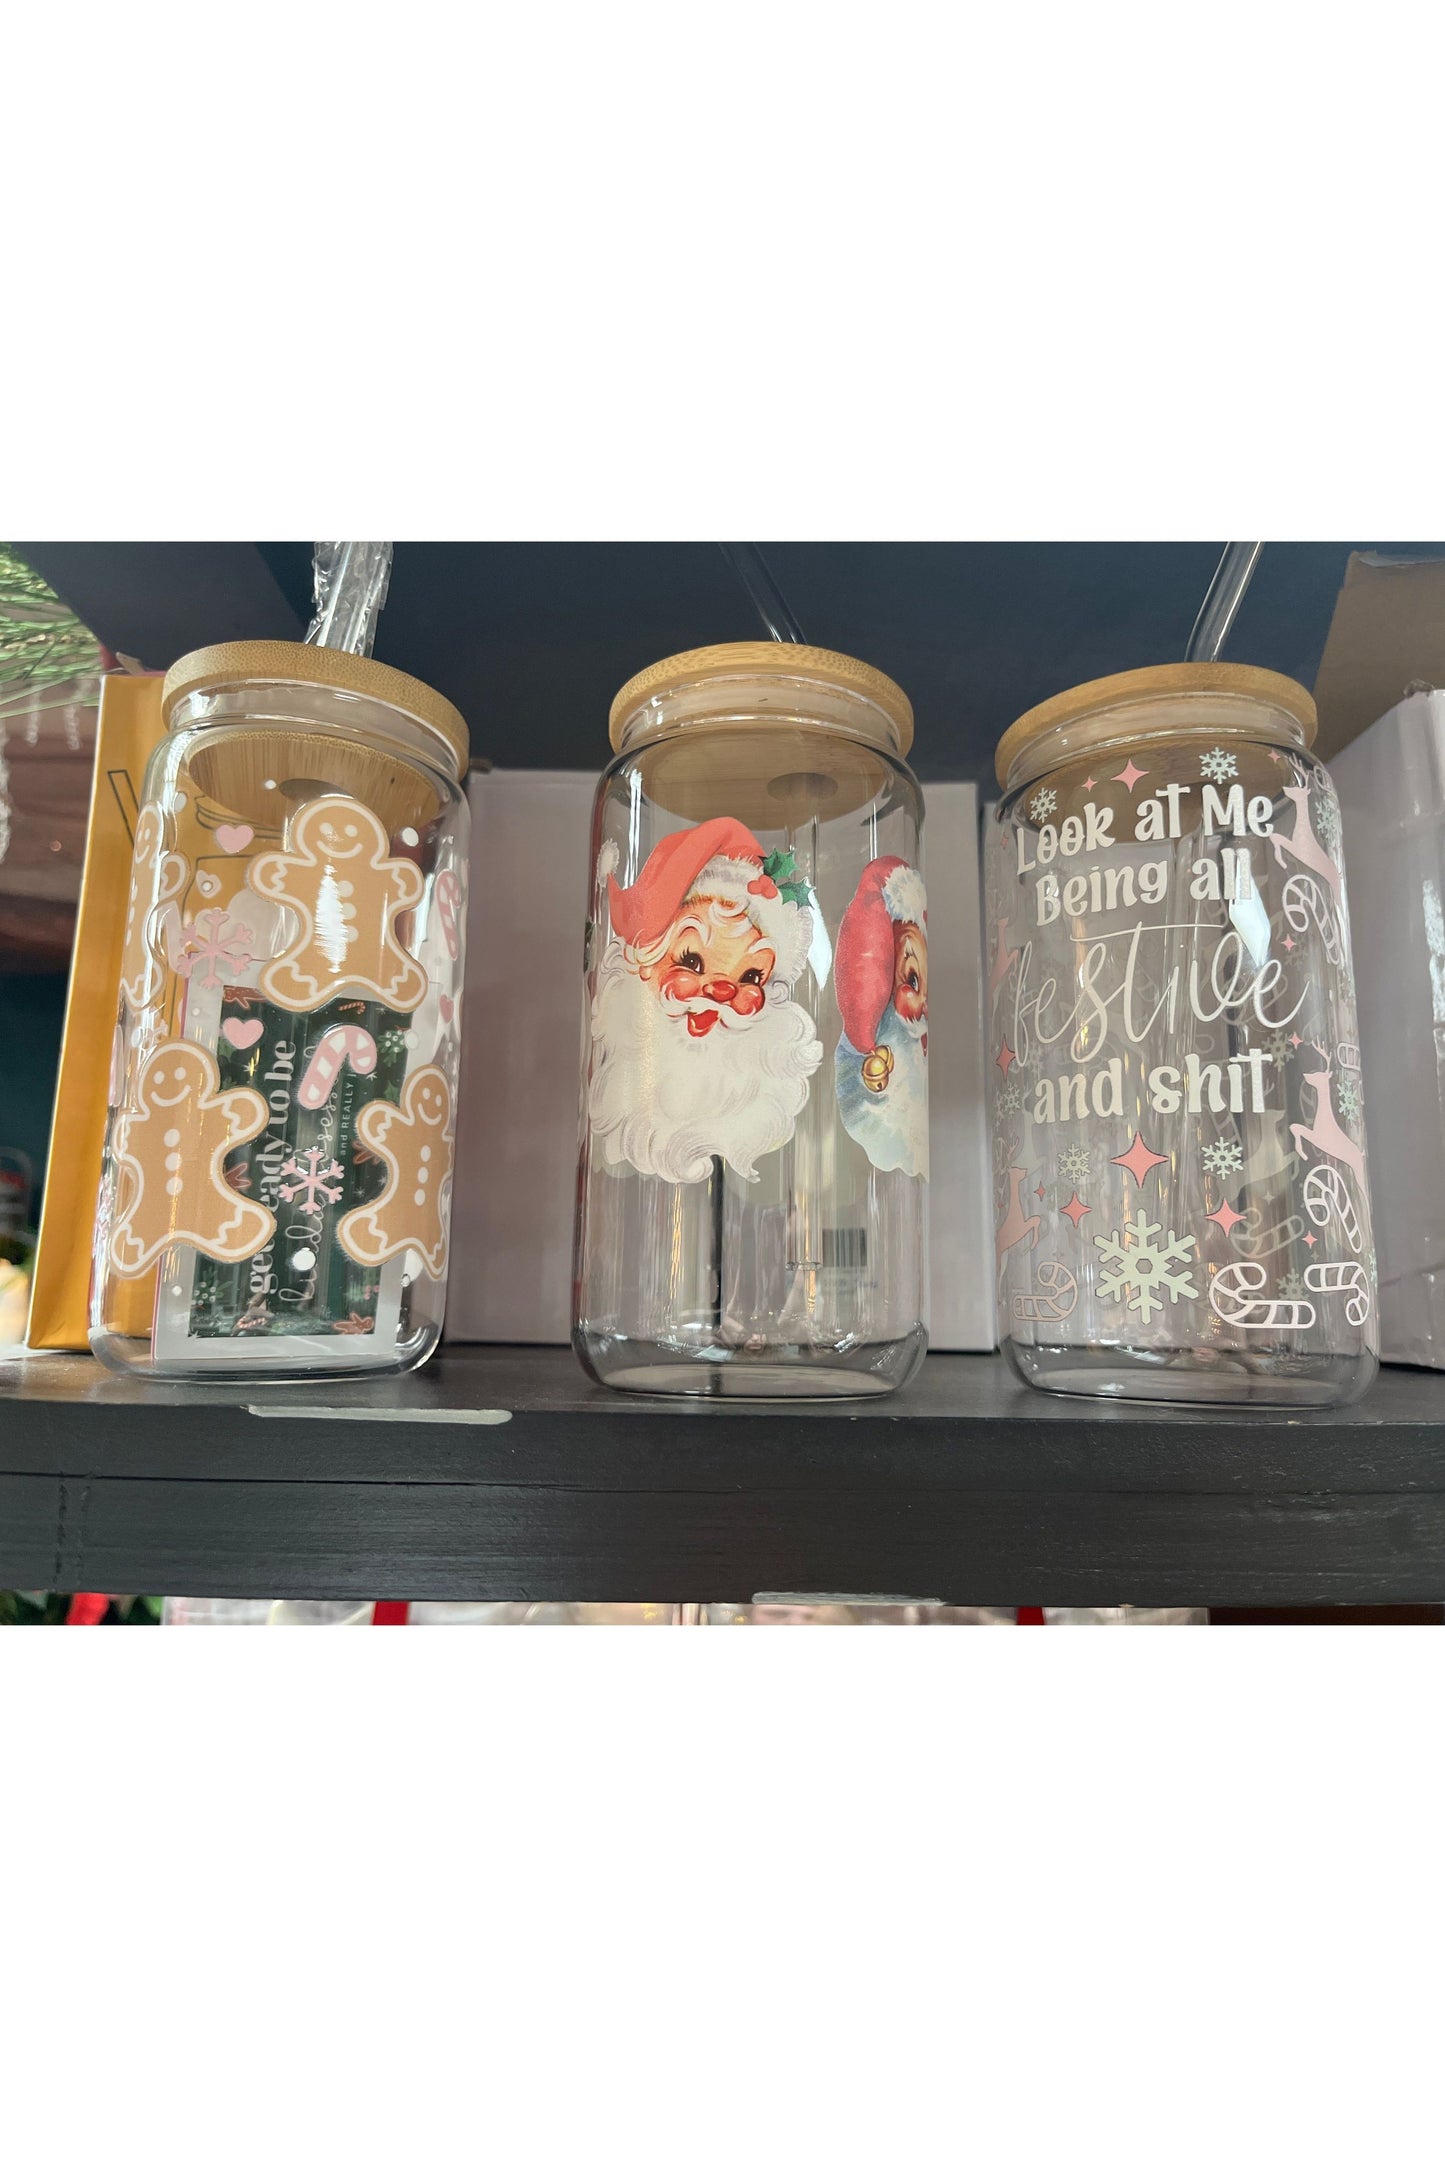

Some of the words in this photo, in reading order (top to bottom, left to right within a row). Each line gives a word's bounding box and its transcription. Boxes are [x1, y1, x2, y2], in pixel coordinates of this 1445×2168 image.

[1016, 802, 1116, 876] Look
[1135, 783, 1191, 841] at
[1201, 783, 1275, 838] Me
[1036, 859, 1169, 927] Being
[1189, 847, 1253, 901] all
[1013, 921, 1310, 1067] festive
[264, 1040, 297, 1082] be
[1034, 1057, 1124, 1124] and
[1148, 1048, 1274, 1114] shit
[339, 1134, 348, 1156] and
[341, 1081, 354, 1129] REALLY
[256, 1131, 292, 1213] eady
[277, 1193, 327, 1301] kida
